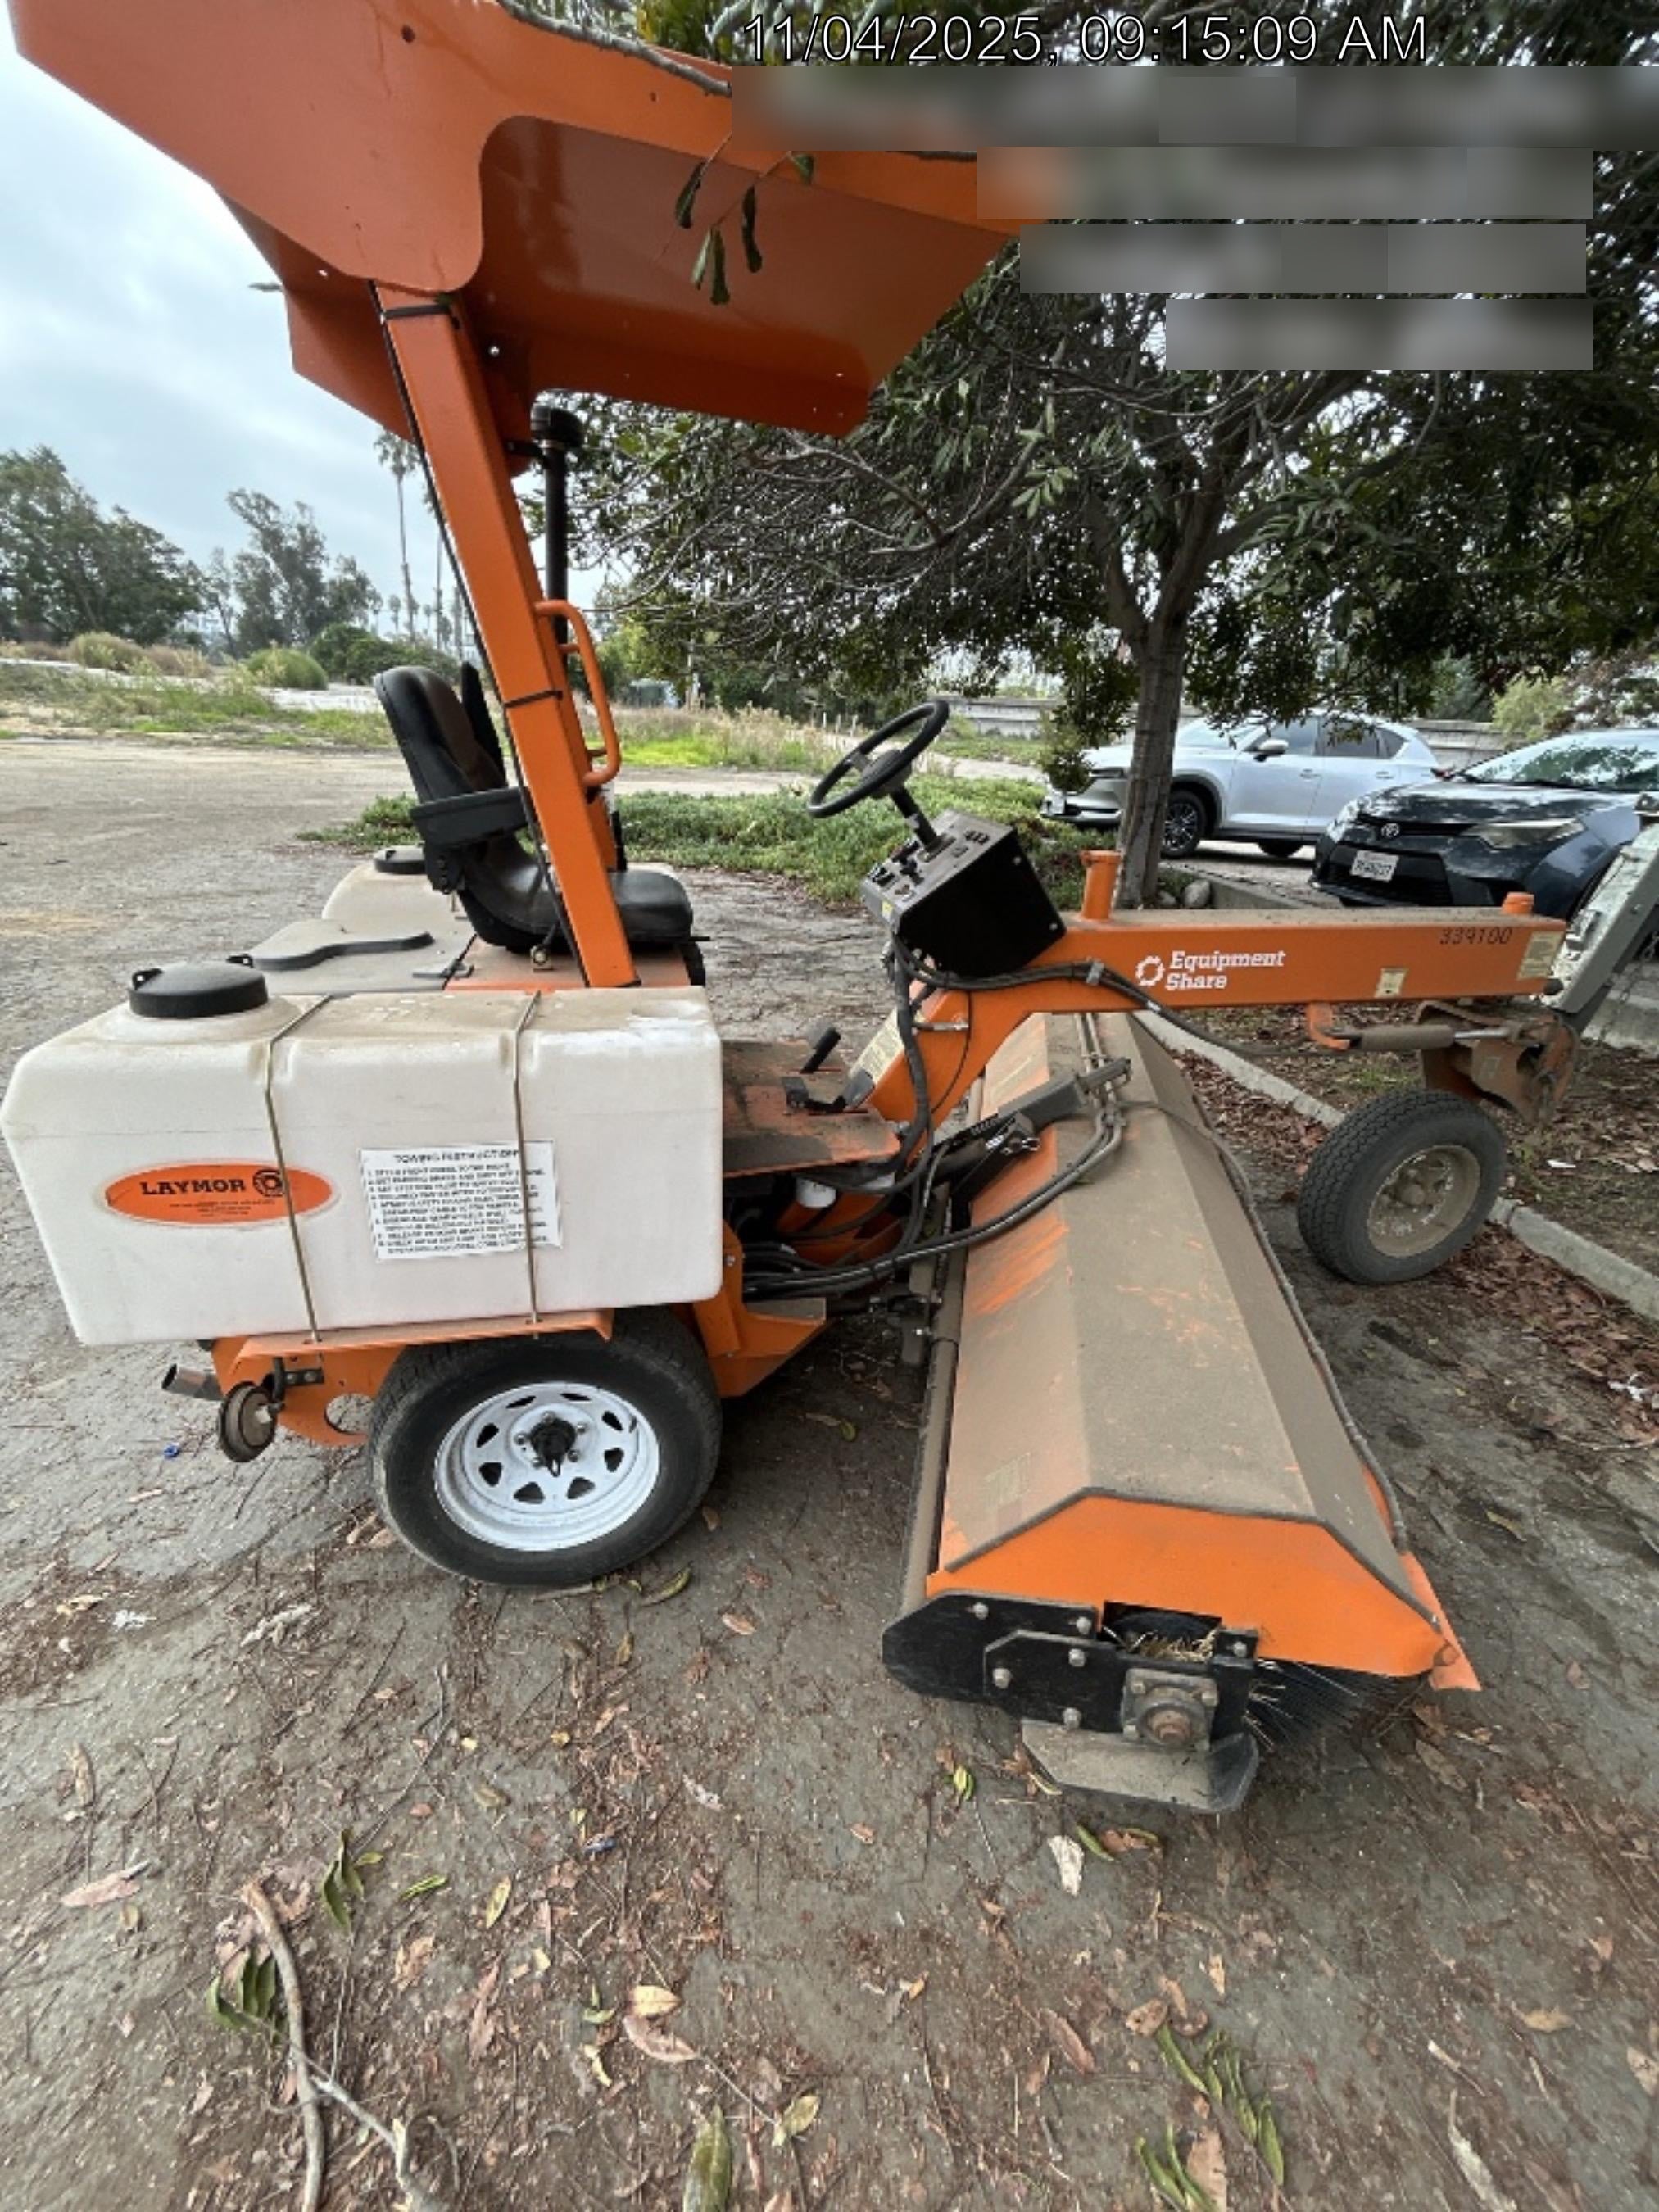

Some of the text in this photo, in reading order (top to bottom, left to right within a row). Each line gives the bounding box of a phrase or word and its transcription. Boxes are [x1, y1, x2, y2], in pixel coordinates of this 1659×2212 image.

[1169, 950, 1285, 972] Equipment
[1165, 972, 1227, 990] Share
[442, 1149, 522, 1162] INSTRUCTION
[140, 1179, 245, 1195] LAYMOR
